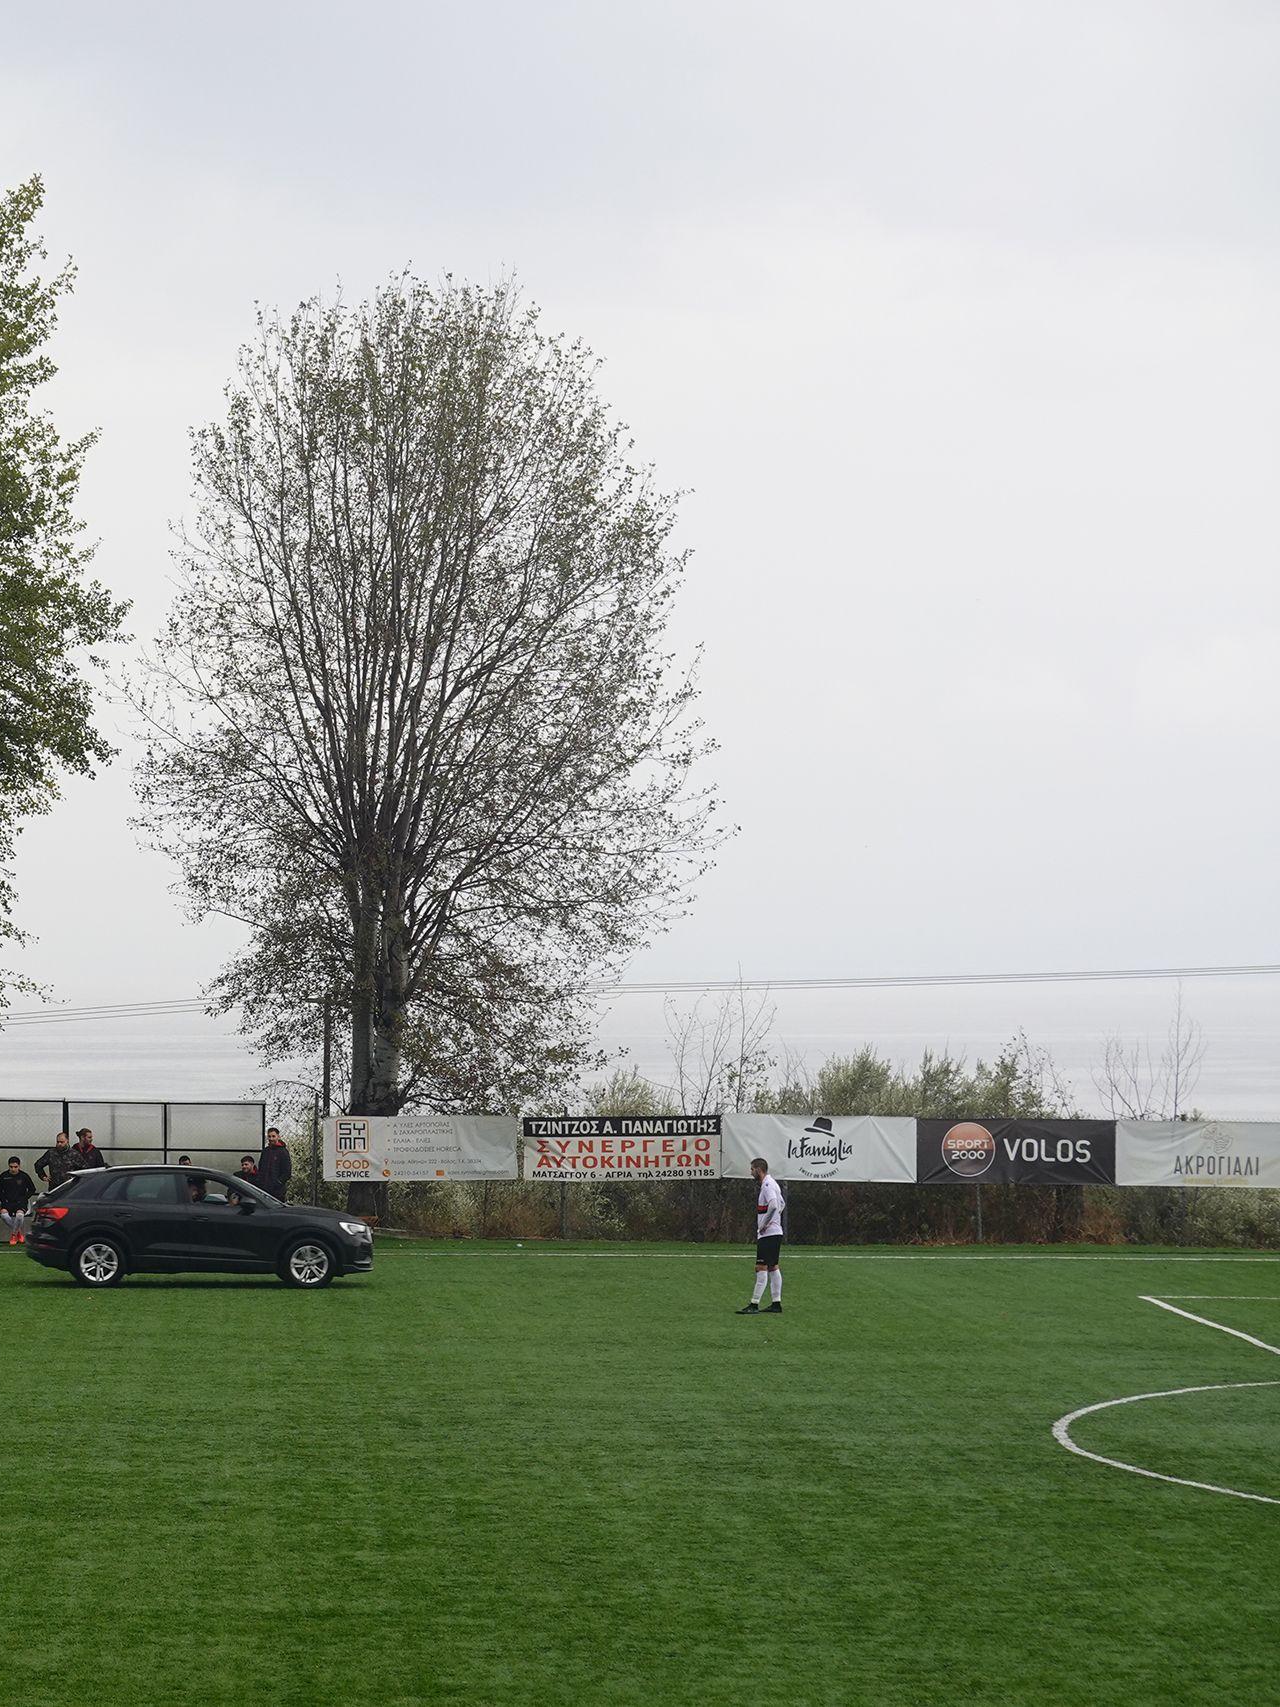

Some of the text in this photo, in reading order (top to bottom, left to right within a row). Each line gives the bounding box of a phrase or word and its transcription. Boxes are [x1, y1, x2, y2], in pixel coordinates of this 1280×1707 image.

[529, 1119, 717, 1134] ΤΖΙΝΤΖΟΣ Α. ΠΑΝΑΓΙΩΤΗΣ
[536, 1138, 710, 1153] ΣΥΝΕΡΓΕΙΟ
[947, 1139, 989, 1149] SPORT
[951, 1150, 986, 1160] 2000
[1003, 1138, 1092, 1163] VOLOS
[335, 1160, 370, 1169] FOOD
[536, 1153, 710, 1169] ΑΥΤΟΚΙΝΗΤΩΝ
[1173, 1155, 1259, 1176] ΑΚΡΟΓΙΑΛΙ
[335, 1170, 370, 1178] SERVICE
[532, 1170, 587, 1179] ΜΑΤΣΑΓΓΟΥ
[590, 1170, 596, 1178] 6
[605, 1170, 632, 1178] ΑΓΡΙΑ
[655, 1169, 684, 1178] 24280
[686, 1169, 715, 1178] 91185
